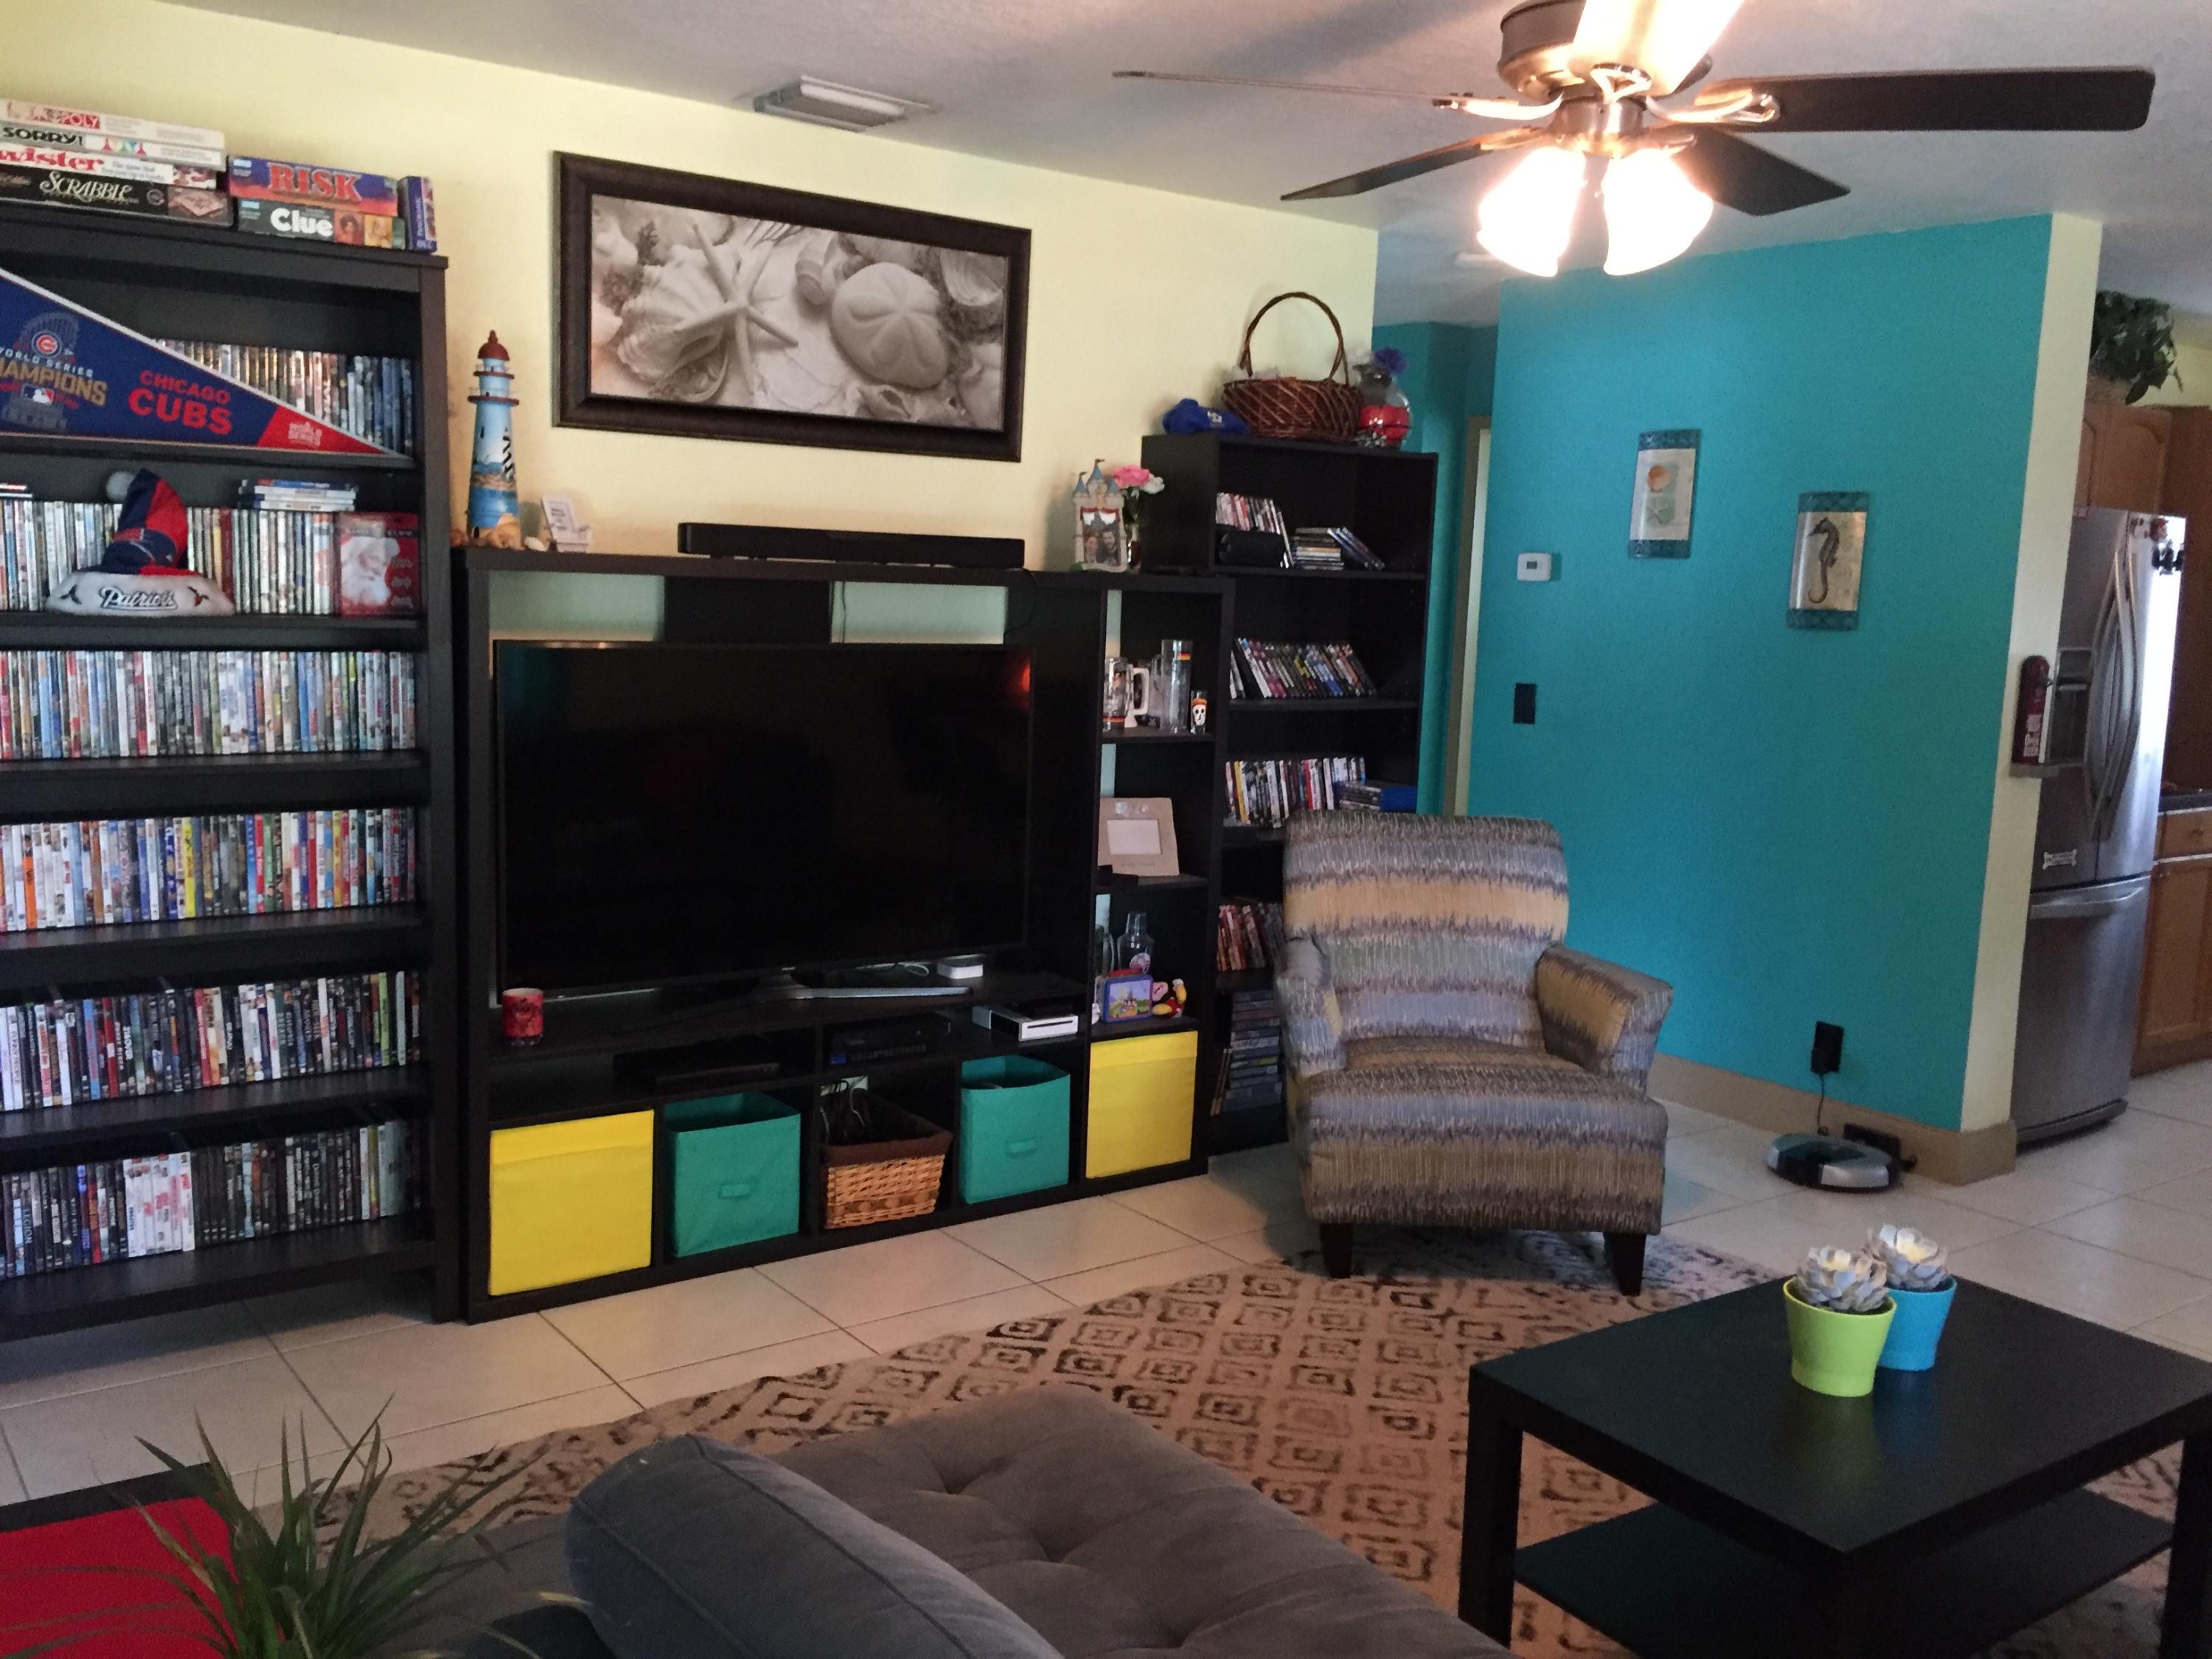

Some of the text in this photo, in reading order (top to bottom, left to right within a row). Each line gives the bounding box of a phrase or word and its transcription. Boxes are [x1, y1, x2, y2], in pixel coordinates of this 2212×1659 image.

[6, 102, 100, 130] NOPOLY
[3, 126, 83, 147] SORRY!
[39, 170, 133, 203] SCRABBLE
[267, 161, 363, 202] RISK
[270, 206, 333, 237] Clue
[46, 358, 94, 378] SERIES
[139, 369, 231, 406] CHICAGO
[128, 388, 232, 436] CUBS
[99, 586, 178, 611] Patriots
[22, 1208, 33, 1245] LEGION
